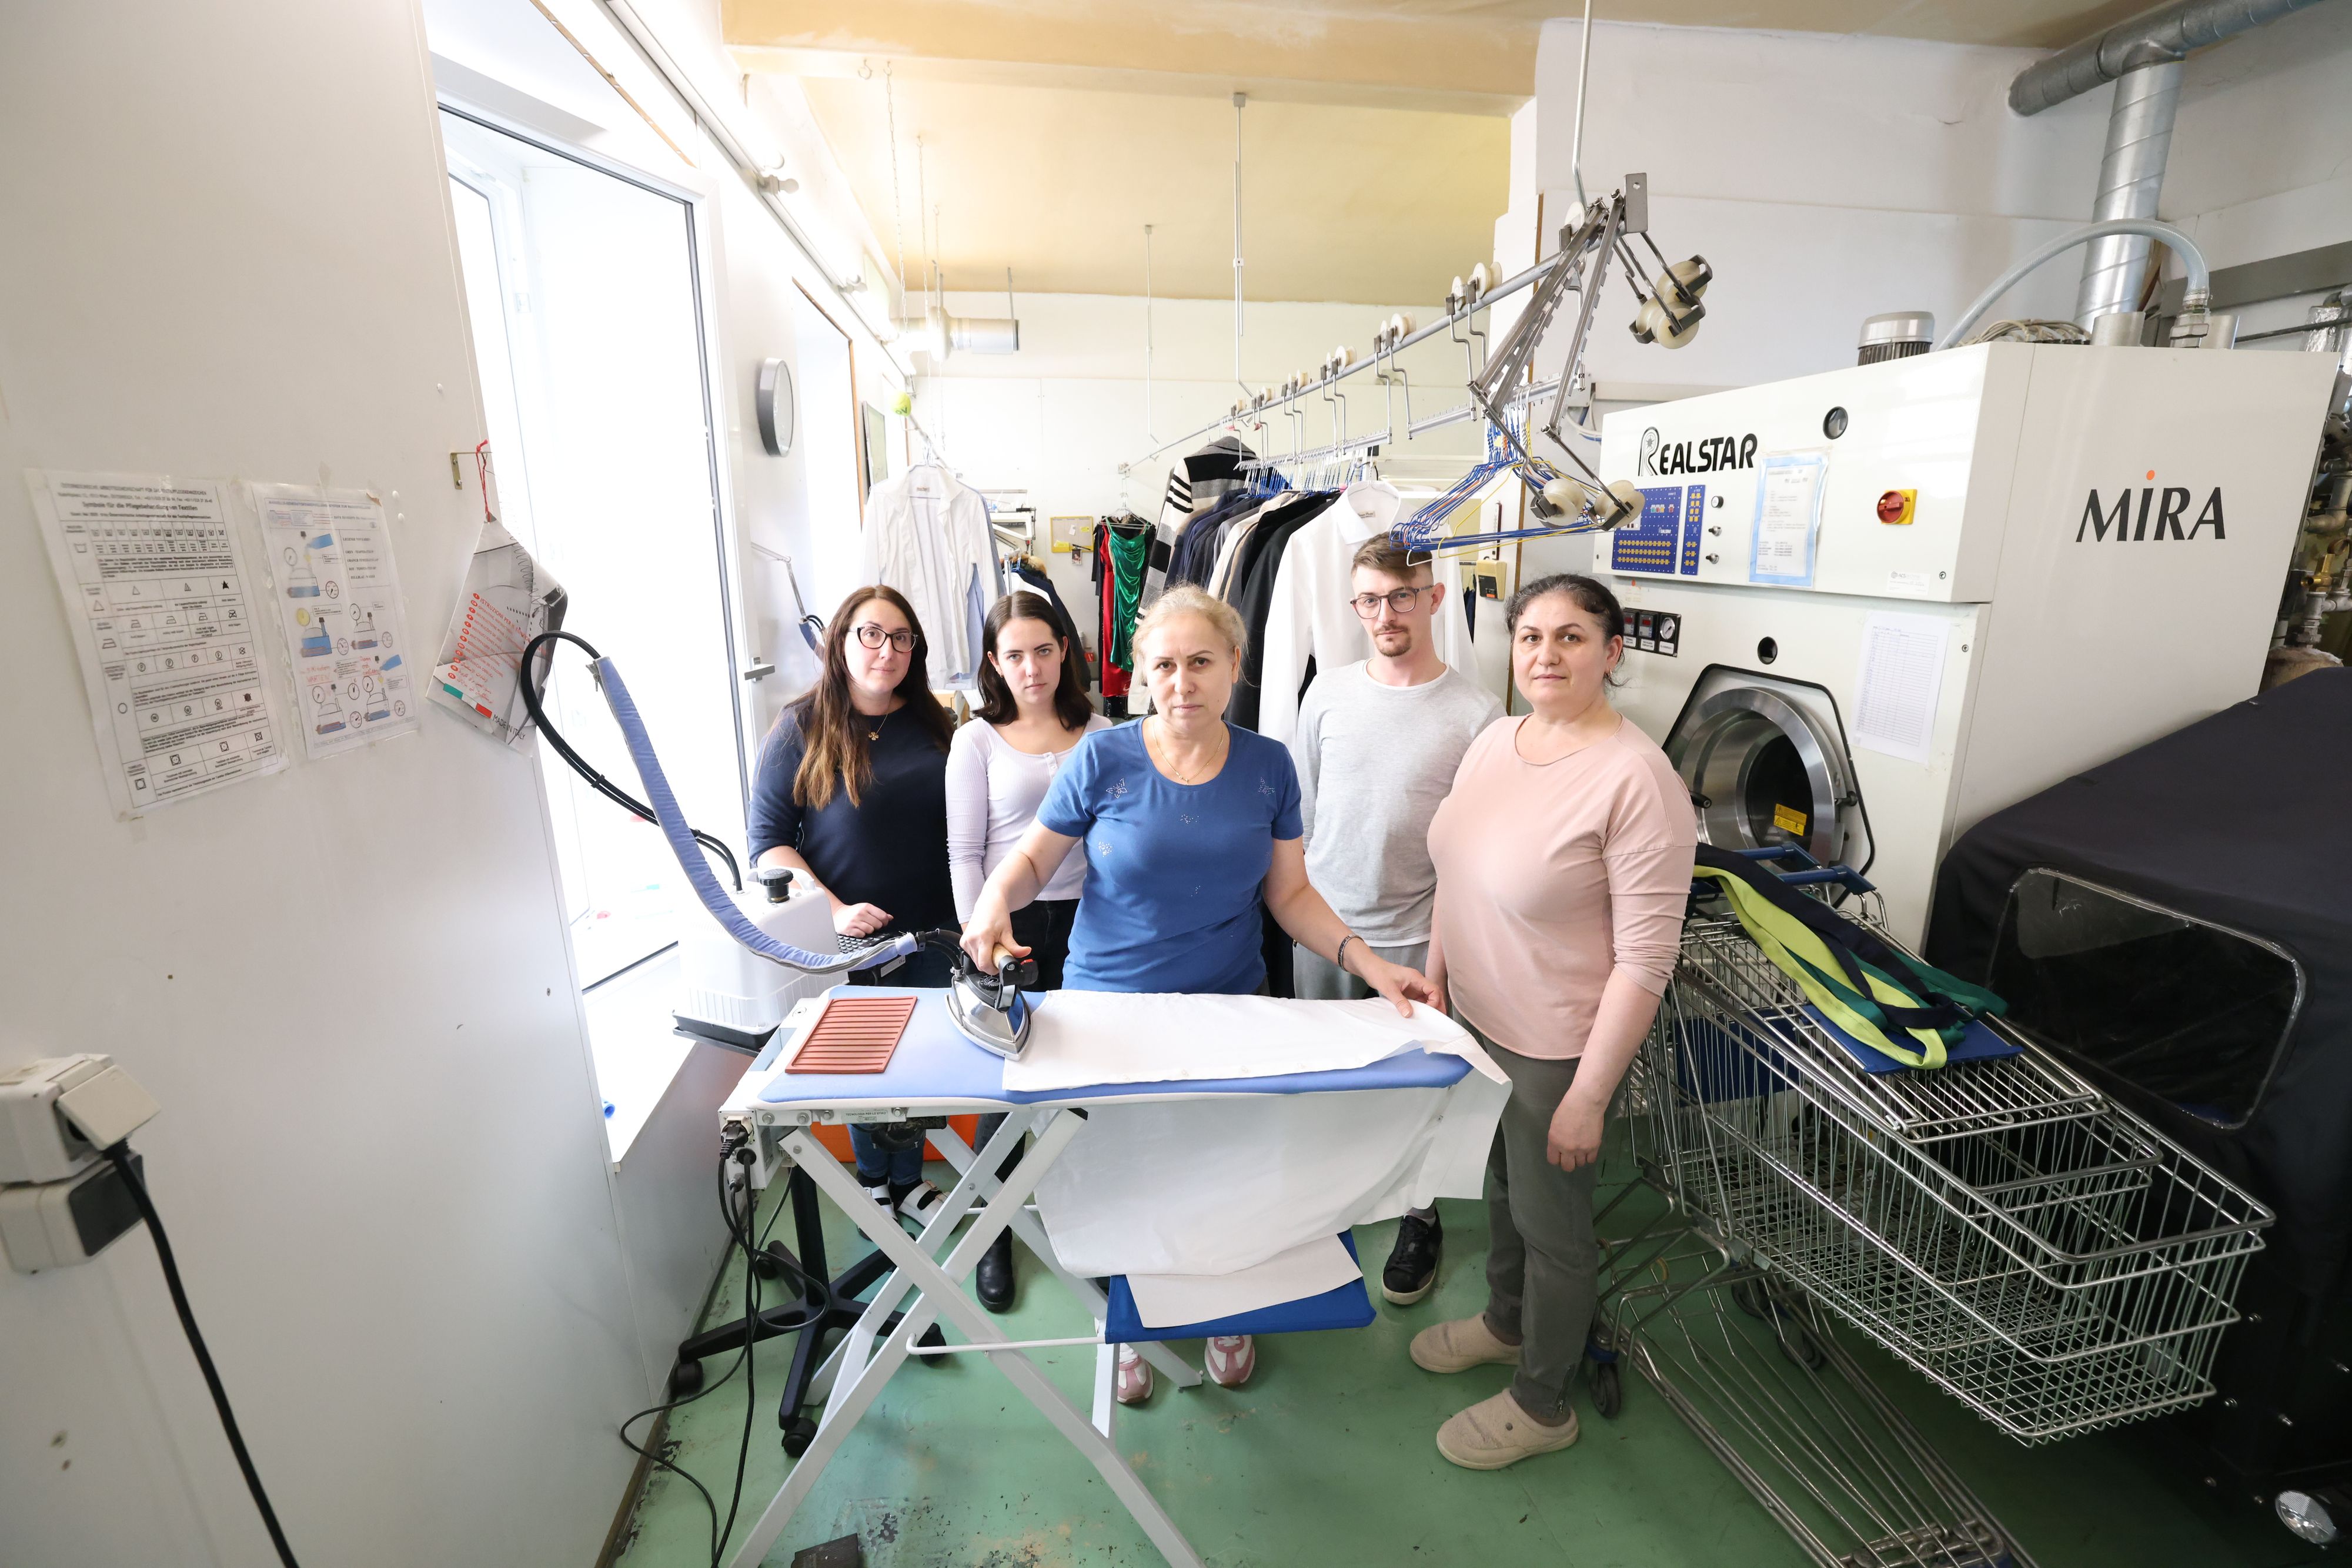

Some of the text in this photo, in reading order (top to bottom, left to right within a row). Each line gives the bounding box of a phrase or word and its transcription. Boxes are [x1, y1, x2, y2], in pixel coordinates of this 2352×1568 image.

[1638, 426, 1758, 476] REALSTAR
[2076, 470, 2226, 542] MIRA
[480, 598, 504, 619] ISTRUZIONI
[493, 714, 526, 740] MADE IN ITALY
